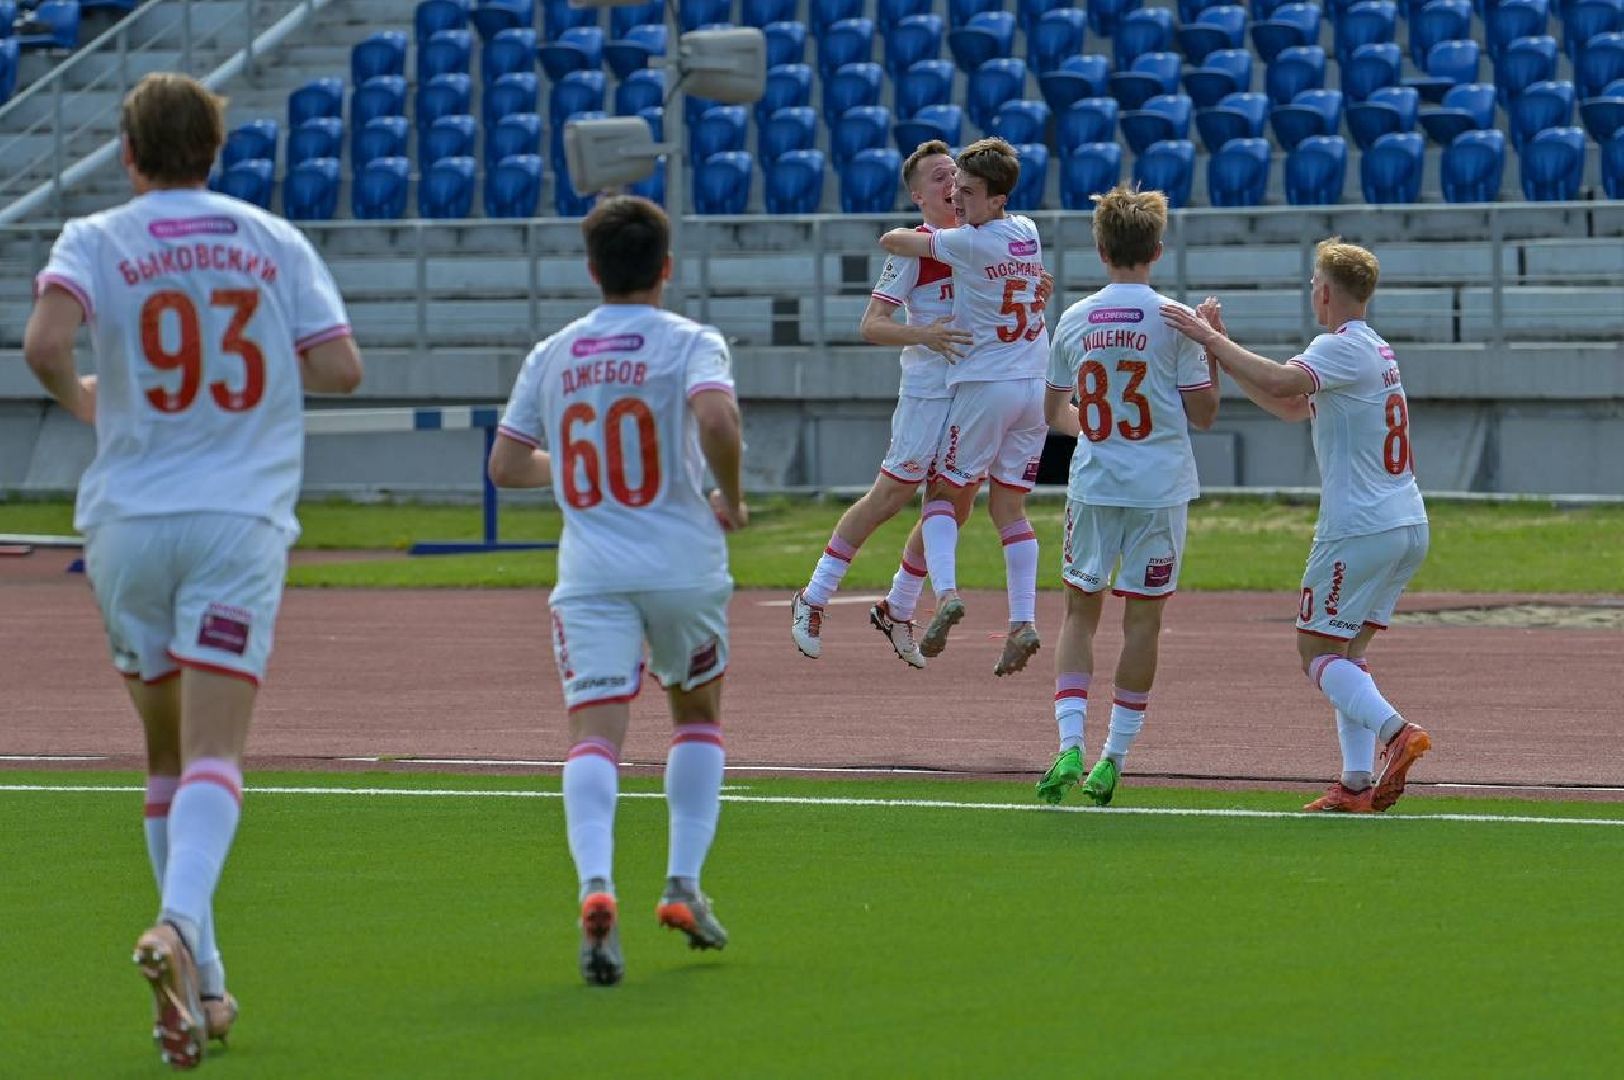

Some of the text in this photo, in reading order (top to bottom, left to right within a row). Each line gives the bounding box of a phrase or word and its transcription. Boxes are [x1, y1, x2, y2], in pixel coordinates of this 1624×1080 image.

[118, 243, 278, 286] БЫКОВСКИЙ
[138, 287, 266, 414] 93
[561, 359, 648, 394] ДЖЕБОВ
[1082, 329, 1147, 352] ИЩЕНКО
[1077, 359, 1153, 442] 83
[1384, 393, 1415, 475] 8
[560, 396, 662, 511] 60
